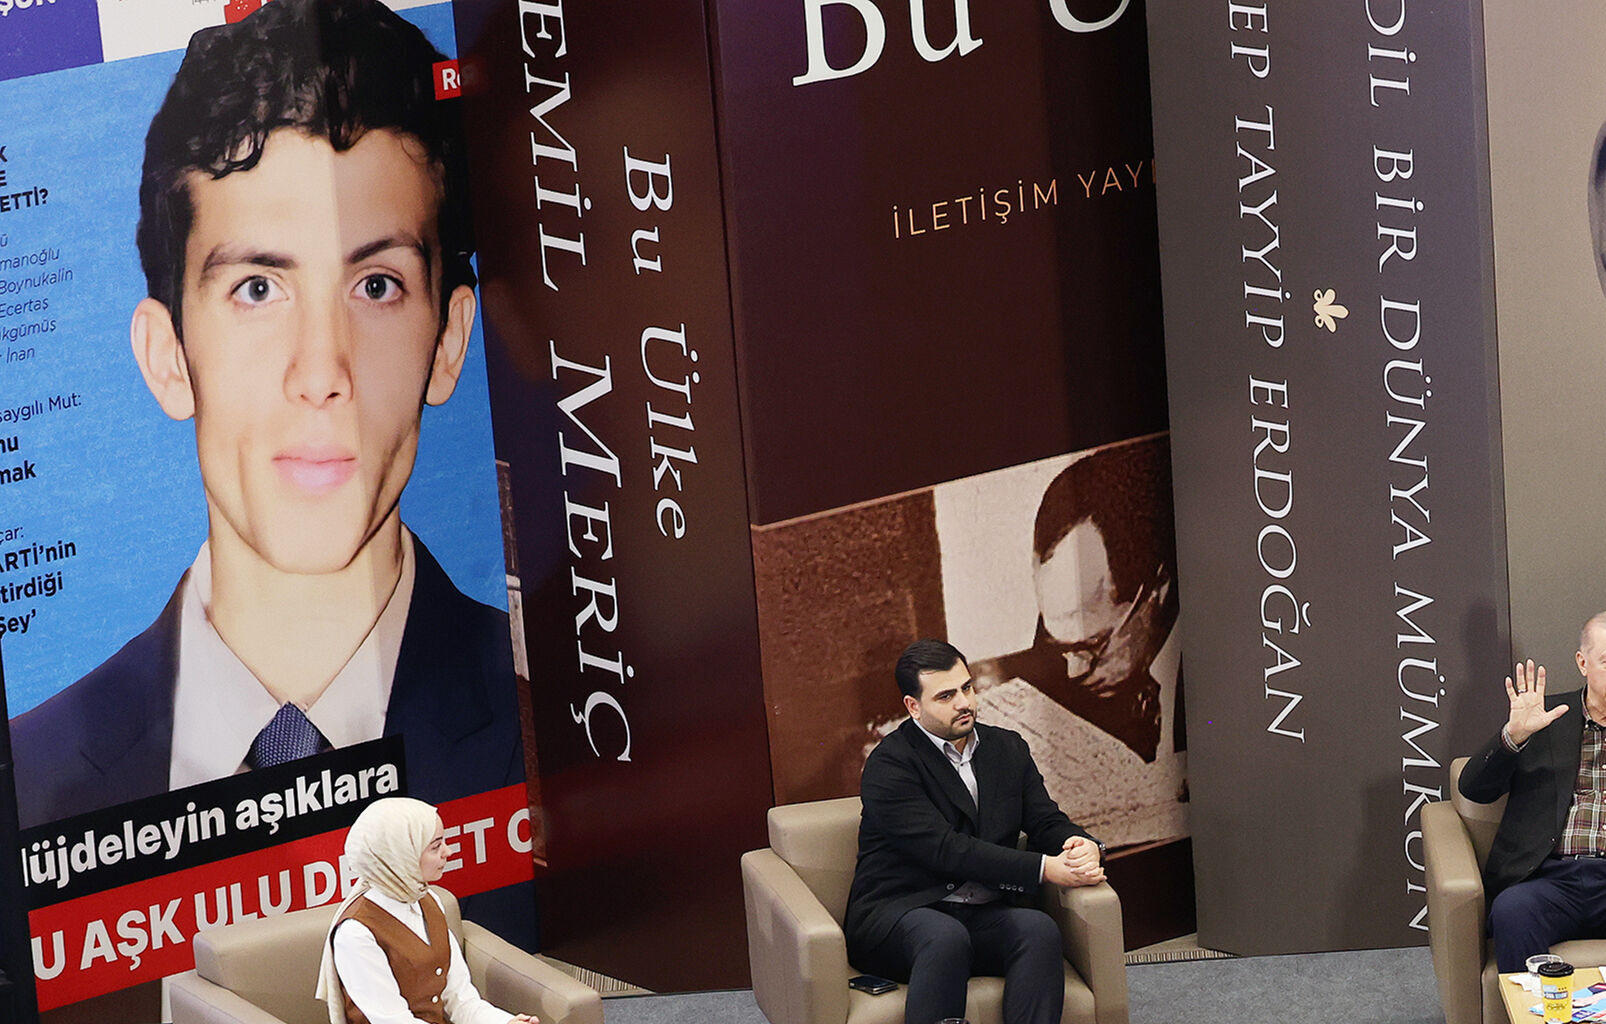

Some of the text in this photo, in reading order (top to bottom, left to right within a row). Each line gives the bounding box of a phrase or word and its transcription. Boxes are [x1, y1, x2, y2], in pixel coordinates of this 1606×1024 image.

[892, 159, 1156, 239] İLETİŞİM YAY
[1235, 105, 1291, 348] TAYYİP
[1373, 144, 1424, 272] BİR
[49, 392, 82, 411] Mut:
[623, 146, 700, 540] Bu Ülke
[1380, 295, 1433, 560] DÜNYA
[549, 340, 635, 763] MERİÇ
[1249, 374, 1312, 743] ERDOĞAN
[21, 761, 398, 889] üjdeleyin aşıklara
[80, 897, 186, 971] AŞK
[194, 869, 292, 931] ULU
